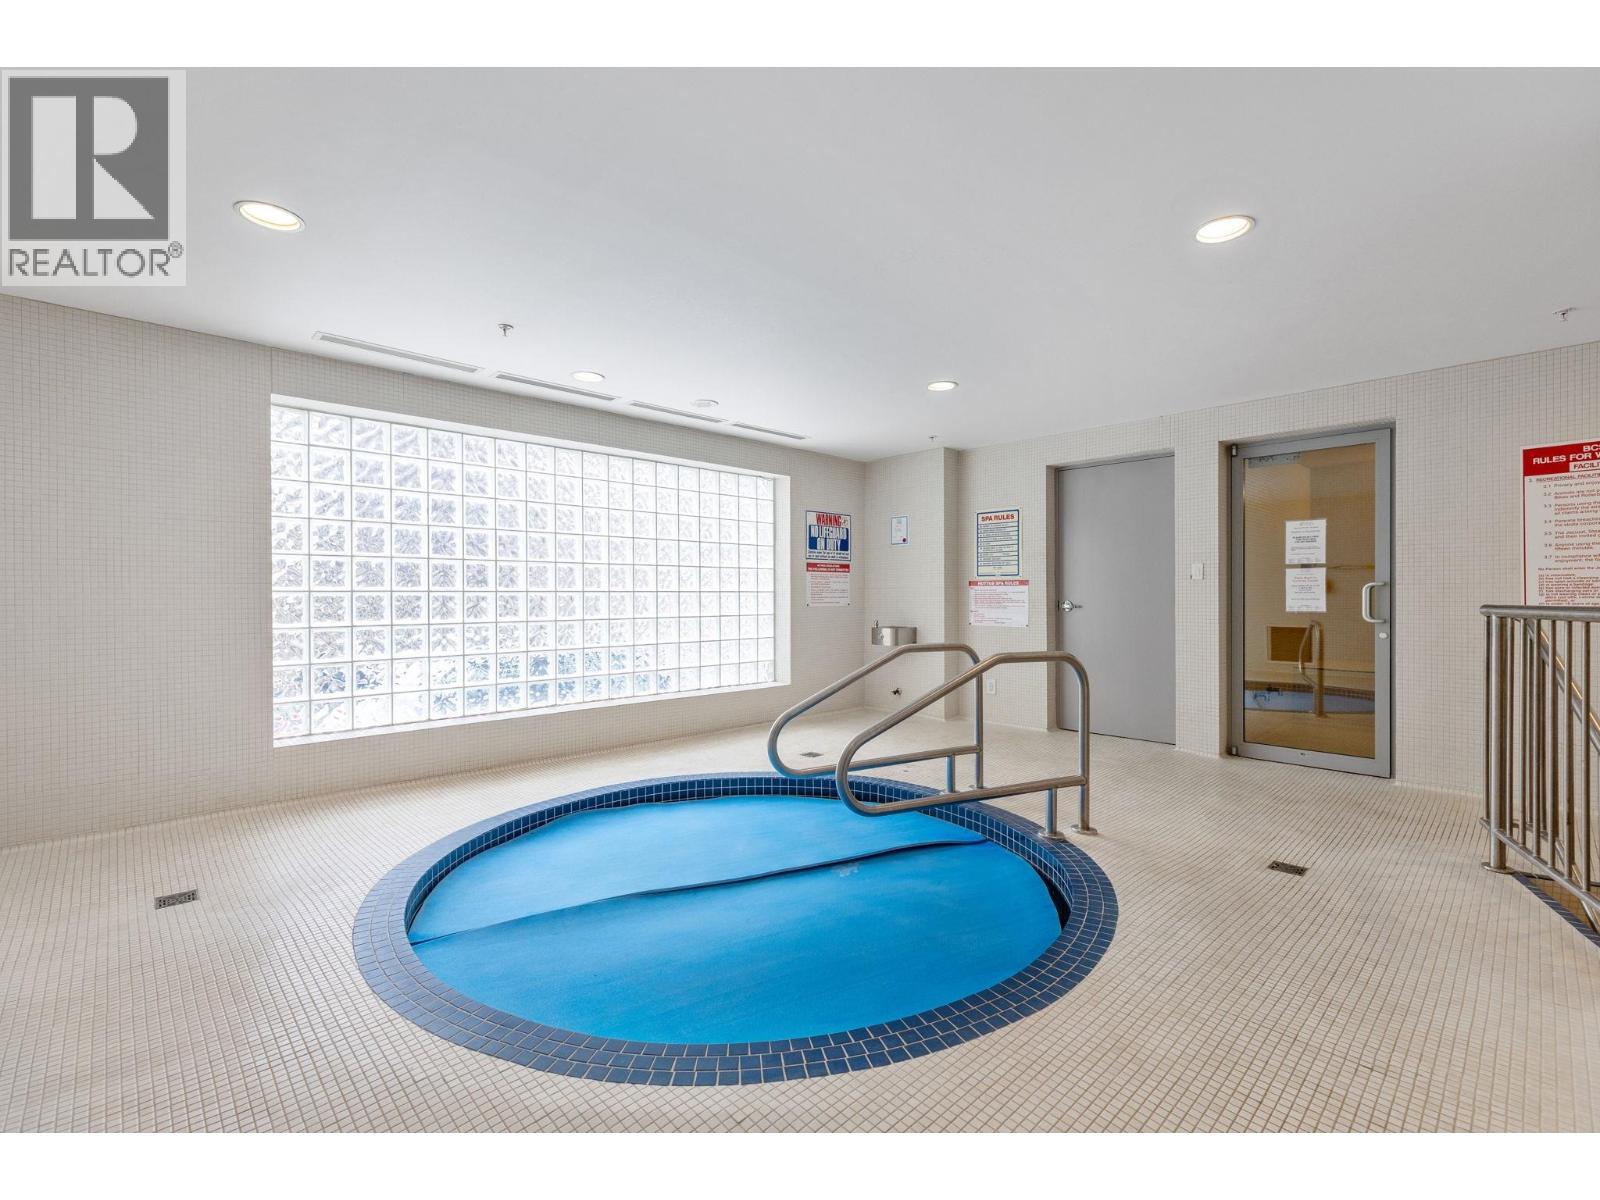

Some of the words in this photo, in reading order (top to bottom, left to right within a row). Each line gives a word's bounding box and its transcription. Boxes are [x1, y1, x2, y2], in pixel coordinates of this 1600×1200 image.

[1533, 455, 1566, 465] RULES
[1570, 453, 1592, 461] FOR
[816, 513, 841, 528] WARNING
[994, 513, 1015, 521] RULES
